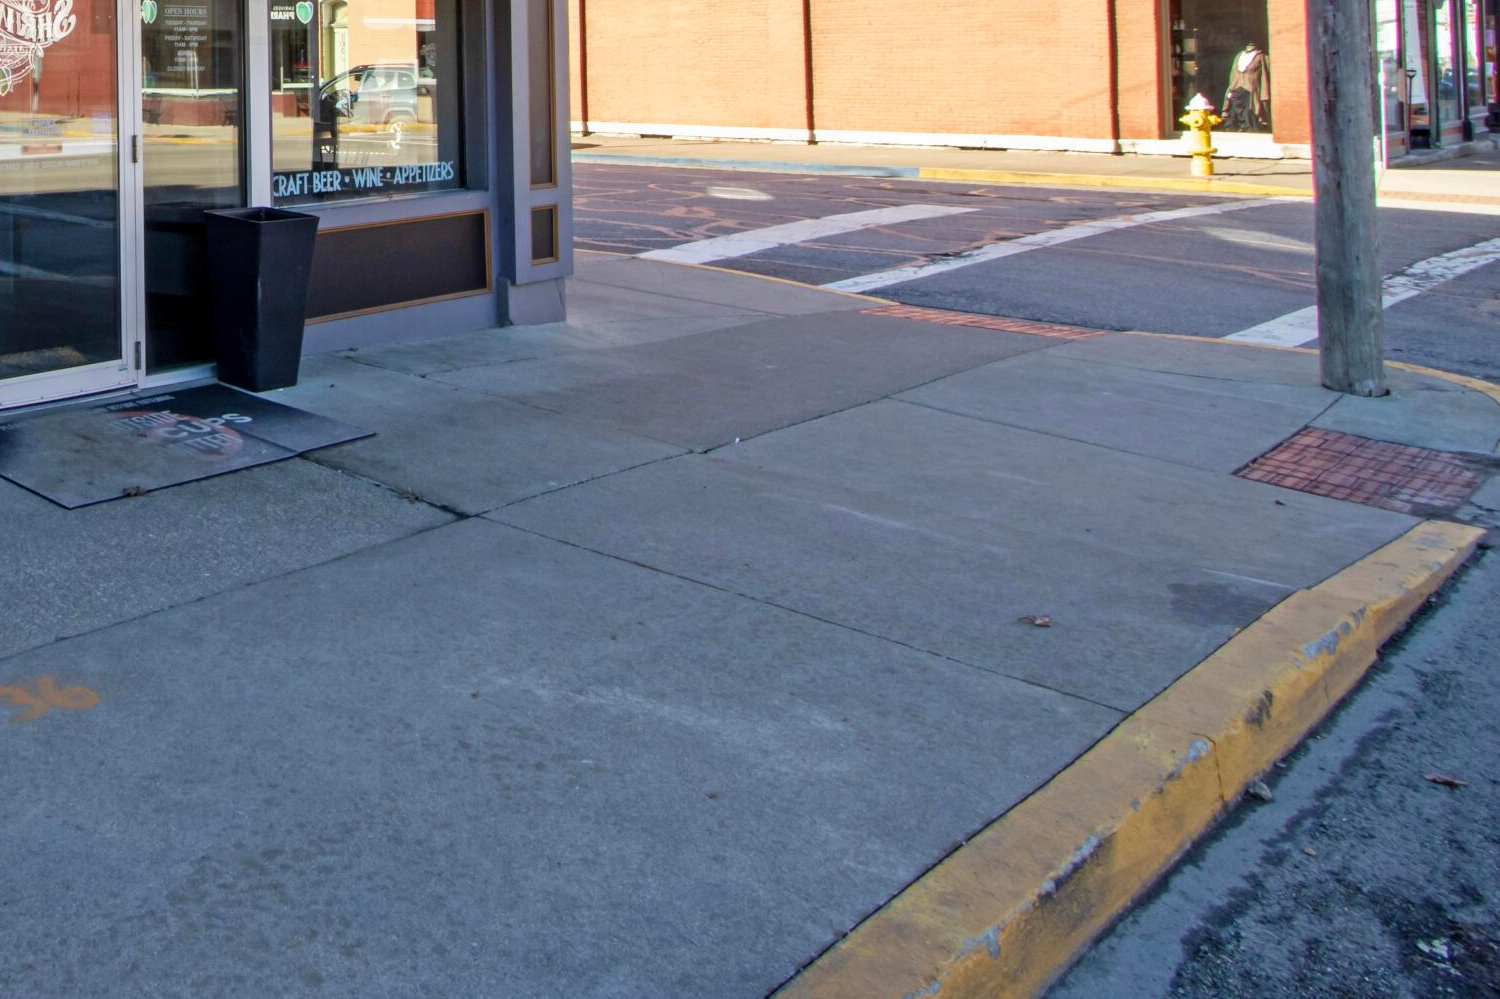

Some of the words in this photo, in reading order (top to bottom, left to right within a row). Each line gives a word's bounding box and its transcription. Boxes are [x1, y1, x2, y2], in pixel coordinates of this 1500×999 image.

[273, 173, 309, 197] CRAFT
[312, 171, 341, 193] BEER
[352, 167, 384, 188] WINE
[394, 161, 455, 185] APPETIZERS
[156, 413, 253, 439] CUPS
